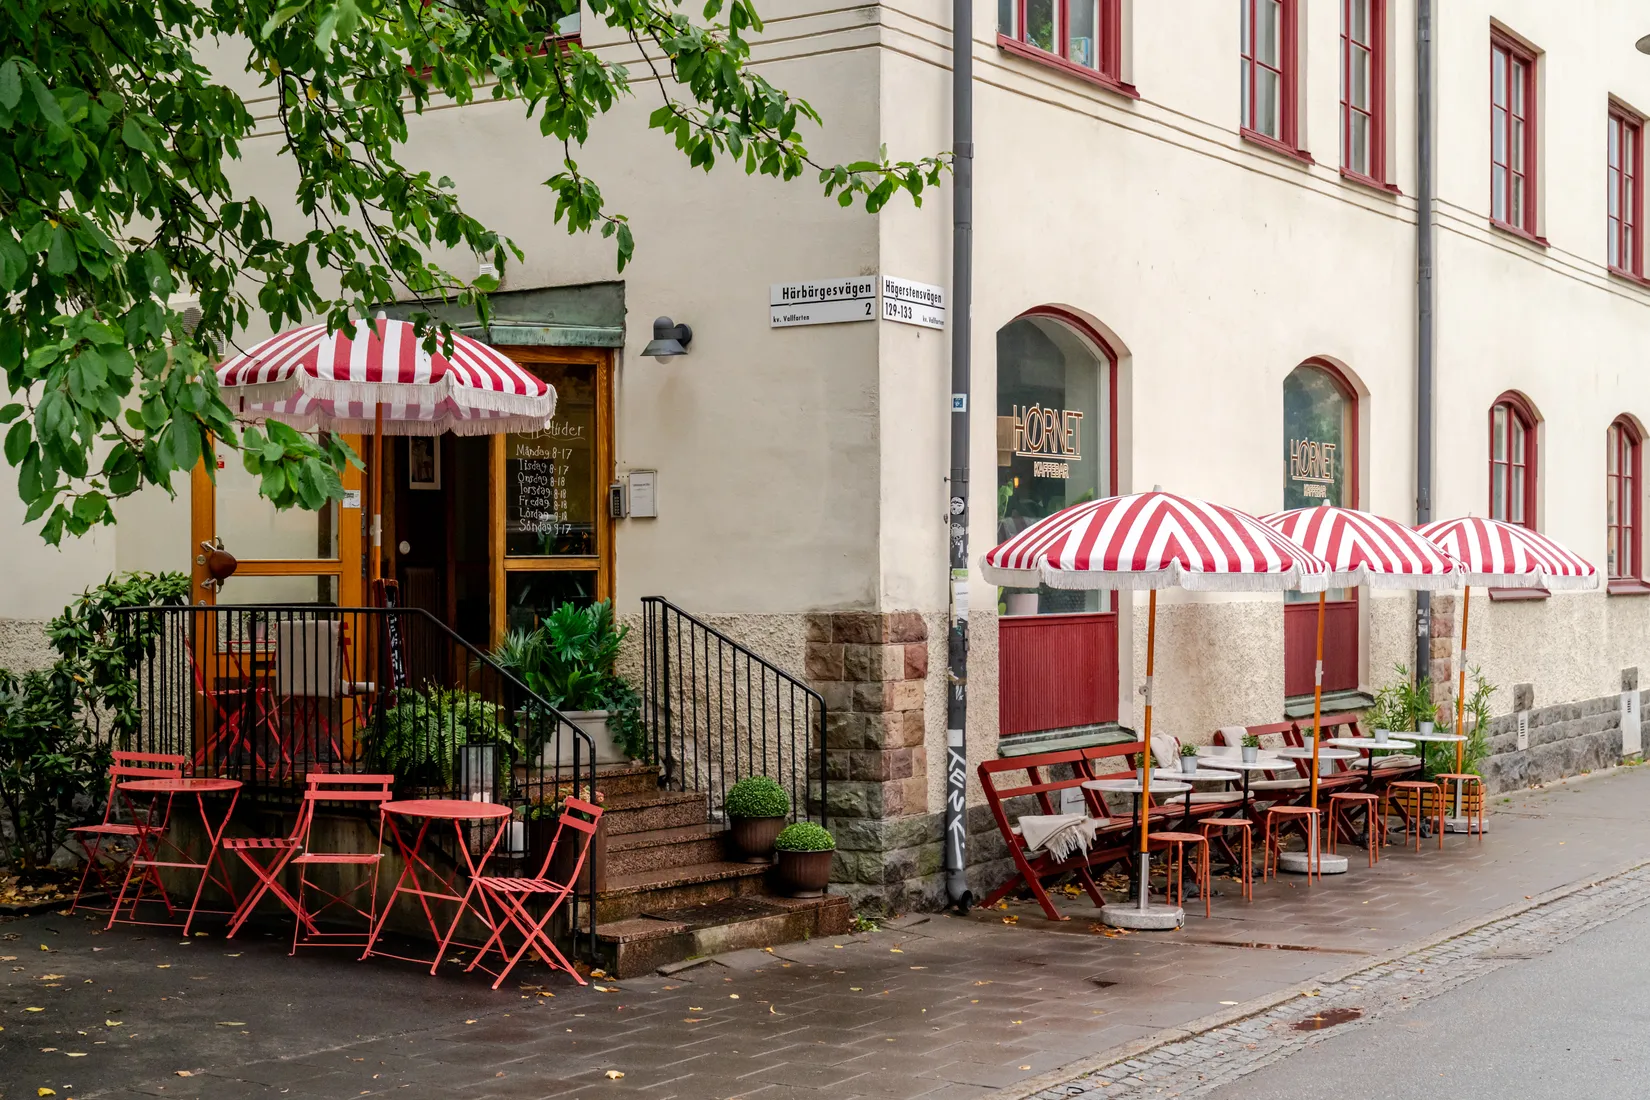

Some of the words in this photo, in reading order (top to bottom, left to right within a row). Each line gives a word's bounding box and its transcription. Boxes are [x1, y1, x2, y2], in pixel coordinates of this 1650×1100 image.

[782, 282, 871, 300] Härbärgesvägen
[885, 279, 942, 305] Hägerstensvägen
[865, 302, 872, 315] 2
[885, 302, 912, 319] 129-133
[773, 315, 781, 323] kv.
[783, 314, 810, 322] Vallfarten
[1013, 402, 1083, 454] HØRNET
[516, 444, 550, 459] Måndag
[552, 447, 573, 459] 8-17
[1290, 437, 1336, 478] HØRNET
[517, 458, 547, 473] Tisdag
[1033, 461, 1069, 479] KAFFEBAR
[517, 472, 548, 486] Onsdag
[550, 476, 566, 487] 8-18
[553, 488, 567, 500] 8-18
[519, 495, 550, 509] Fredag
[553, 500, 568, 511] 8-18
[520, 507, 549, 522] Lördag
[519, 519, 552, 534] Söndag
